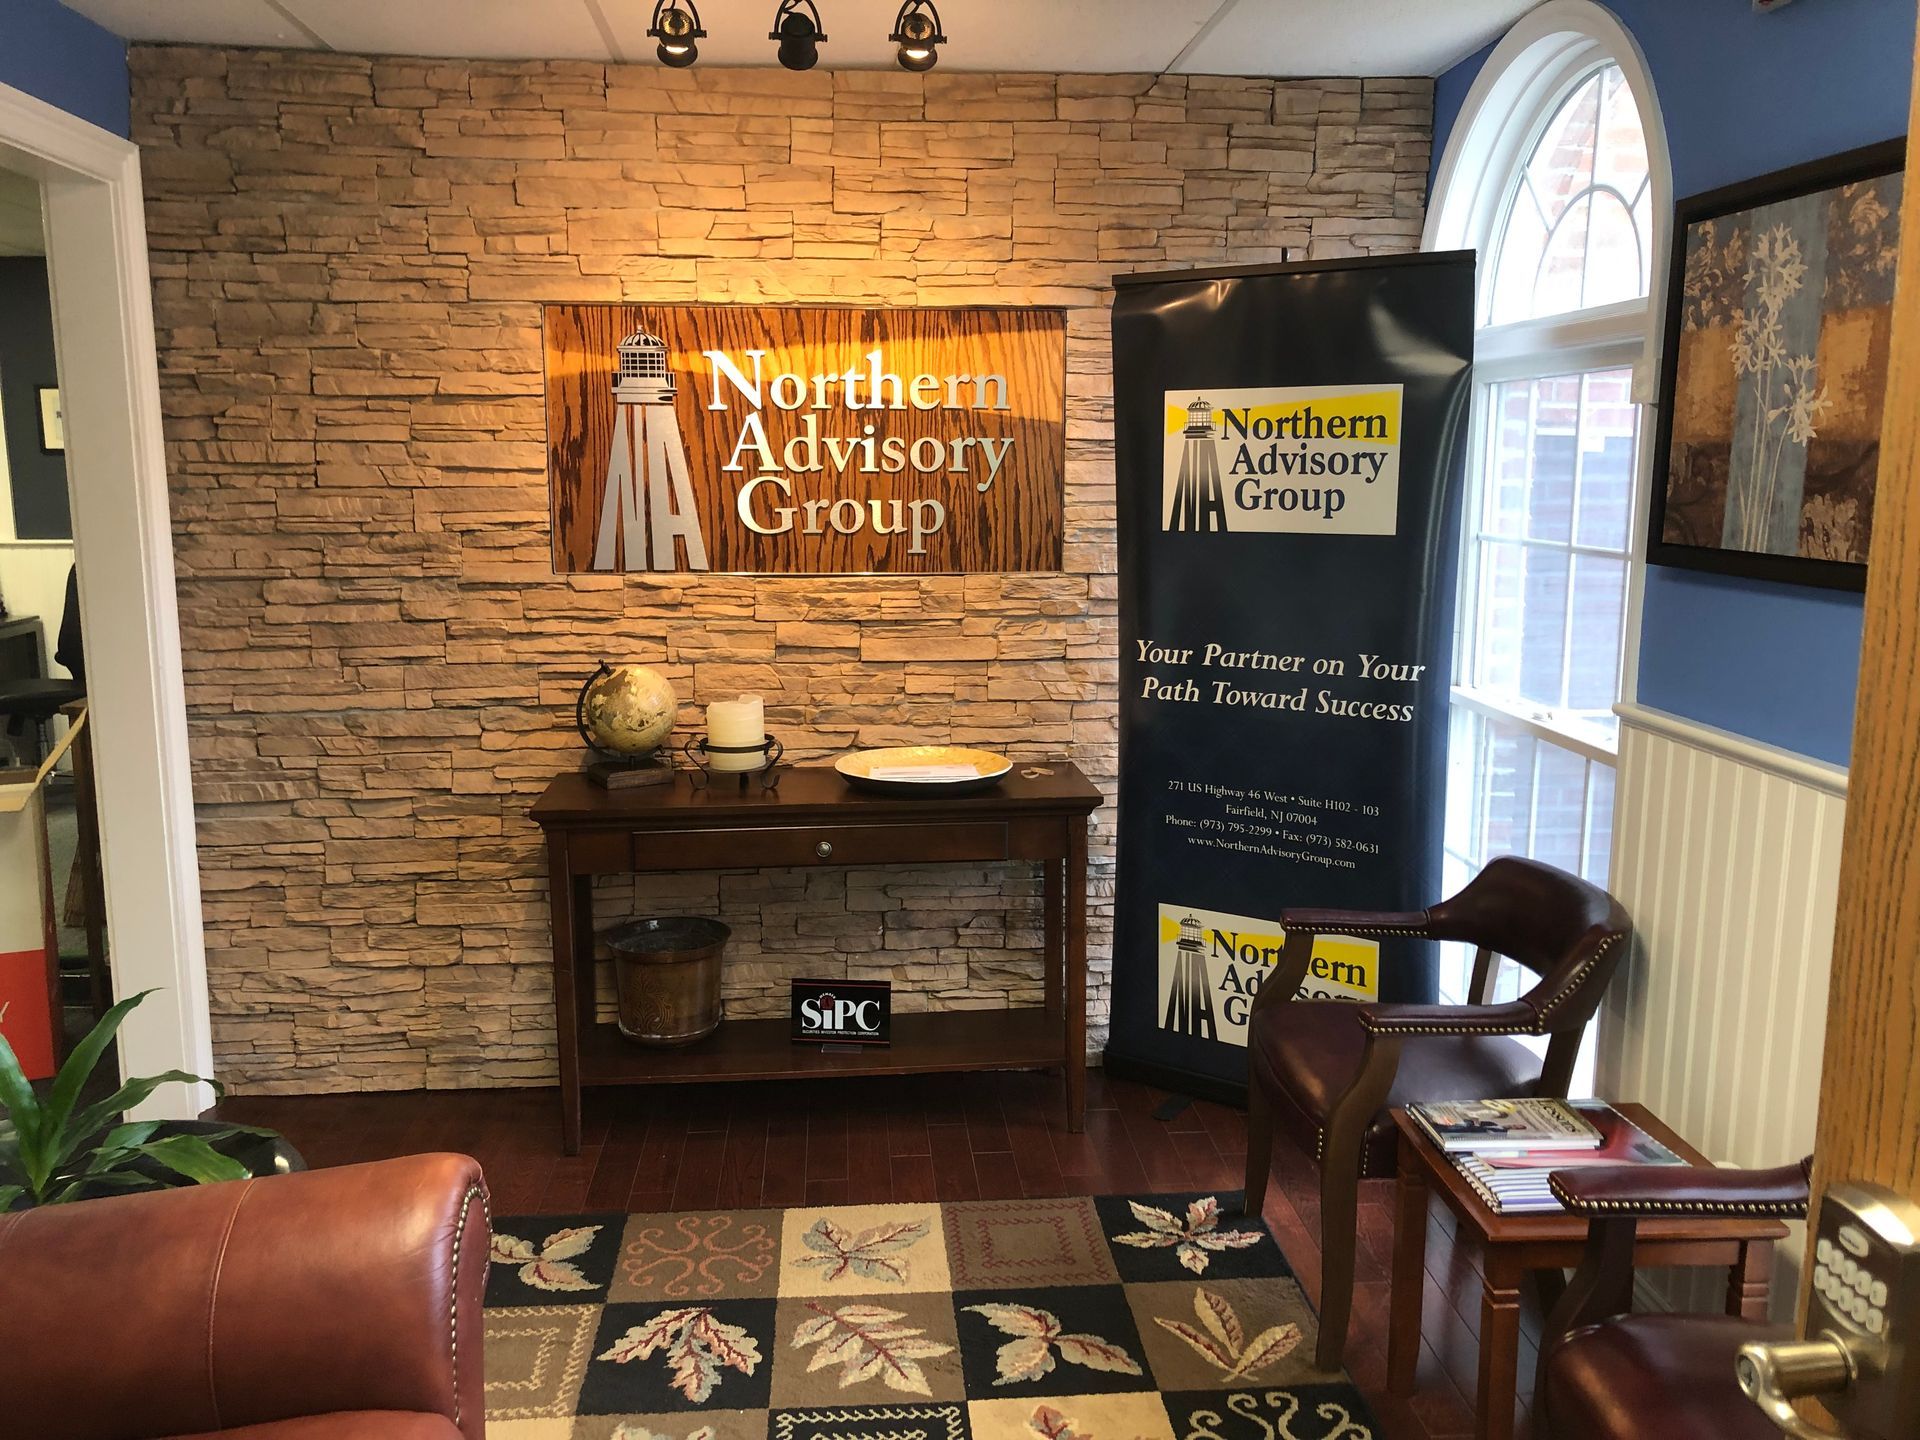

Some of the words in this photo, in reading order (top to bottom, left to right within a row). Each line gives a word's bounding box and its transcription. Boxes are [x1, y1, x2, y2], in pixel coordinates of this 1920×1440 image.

[703, 349, 1012, 412] Northern
[1220, 406, 1388, 441] Northern
[721, 411, 1015, 493] Advisory
[1228, 442, 1389, 484] Advisory
[737, 475, 946, 555] Group
[1234, 477, 1346, 519] Group
[1136, 639, 1194, 666] Your
[1202, 643, 1306, 673] Partner
[1312, 657, 1345, 677] on
[1357, 653, 1426, 682] Your
[1140, 676, 1200, 703] Path
[1211, 680, 1308, 712] Toward
[1315, 690, 1414, 722] Success
[1167, 780, 1184, 791] 271
[1187, 782, 1202, 793] US
[1204, 784, 1246, 800] Highway
[1247, 789, 1261, 800] 46
[1263, 790, 1288, 804] West
[1297, 795, 1323, 808] Suite
[1324, 799, 1351, 813] H102
[1361, 805, 1380, 817] 103
[1225, 803, 1268, 820] Fairfield,
[1270, 810, 1284, 824] NJ
[1286, 812, 1318, 826] 07004
[1165, 814, 1197, 828] Phone:
[1199, 818, 1225, 833] (973)
[1227, 822, 1273, 837] 795-2299
[1282, 829, 1303, 842] Fax:
[1305, 833, 1332, 849] (973)
[1334, 837, 1380, 854] 582-0631
[1187, 835, 1356, 869] www.NorthernAdvisoryGroup.com
